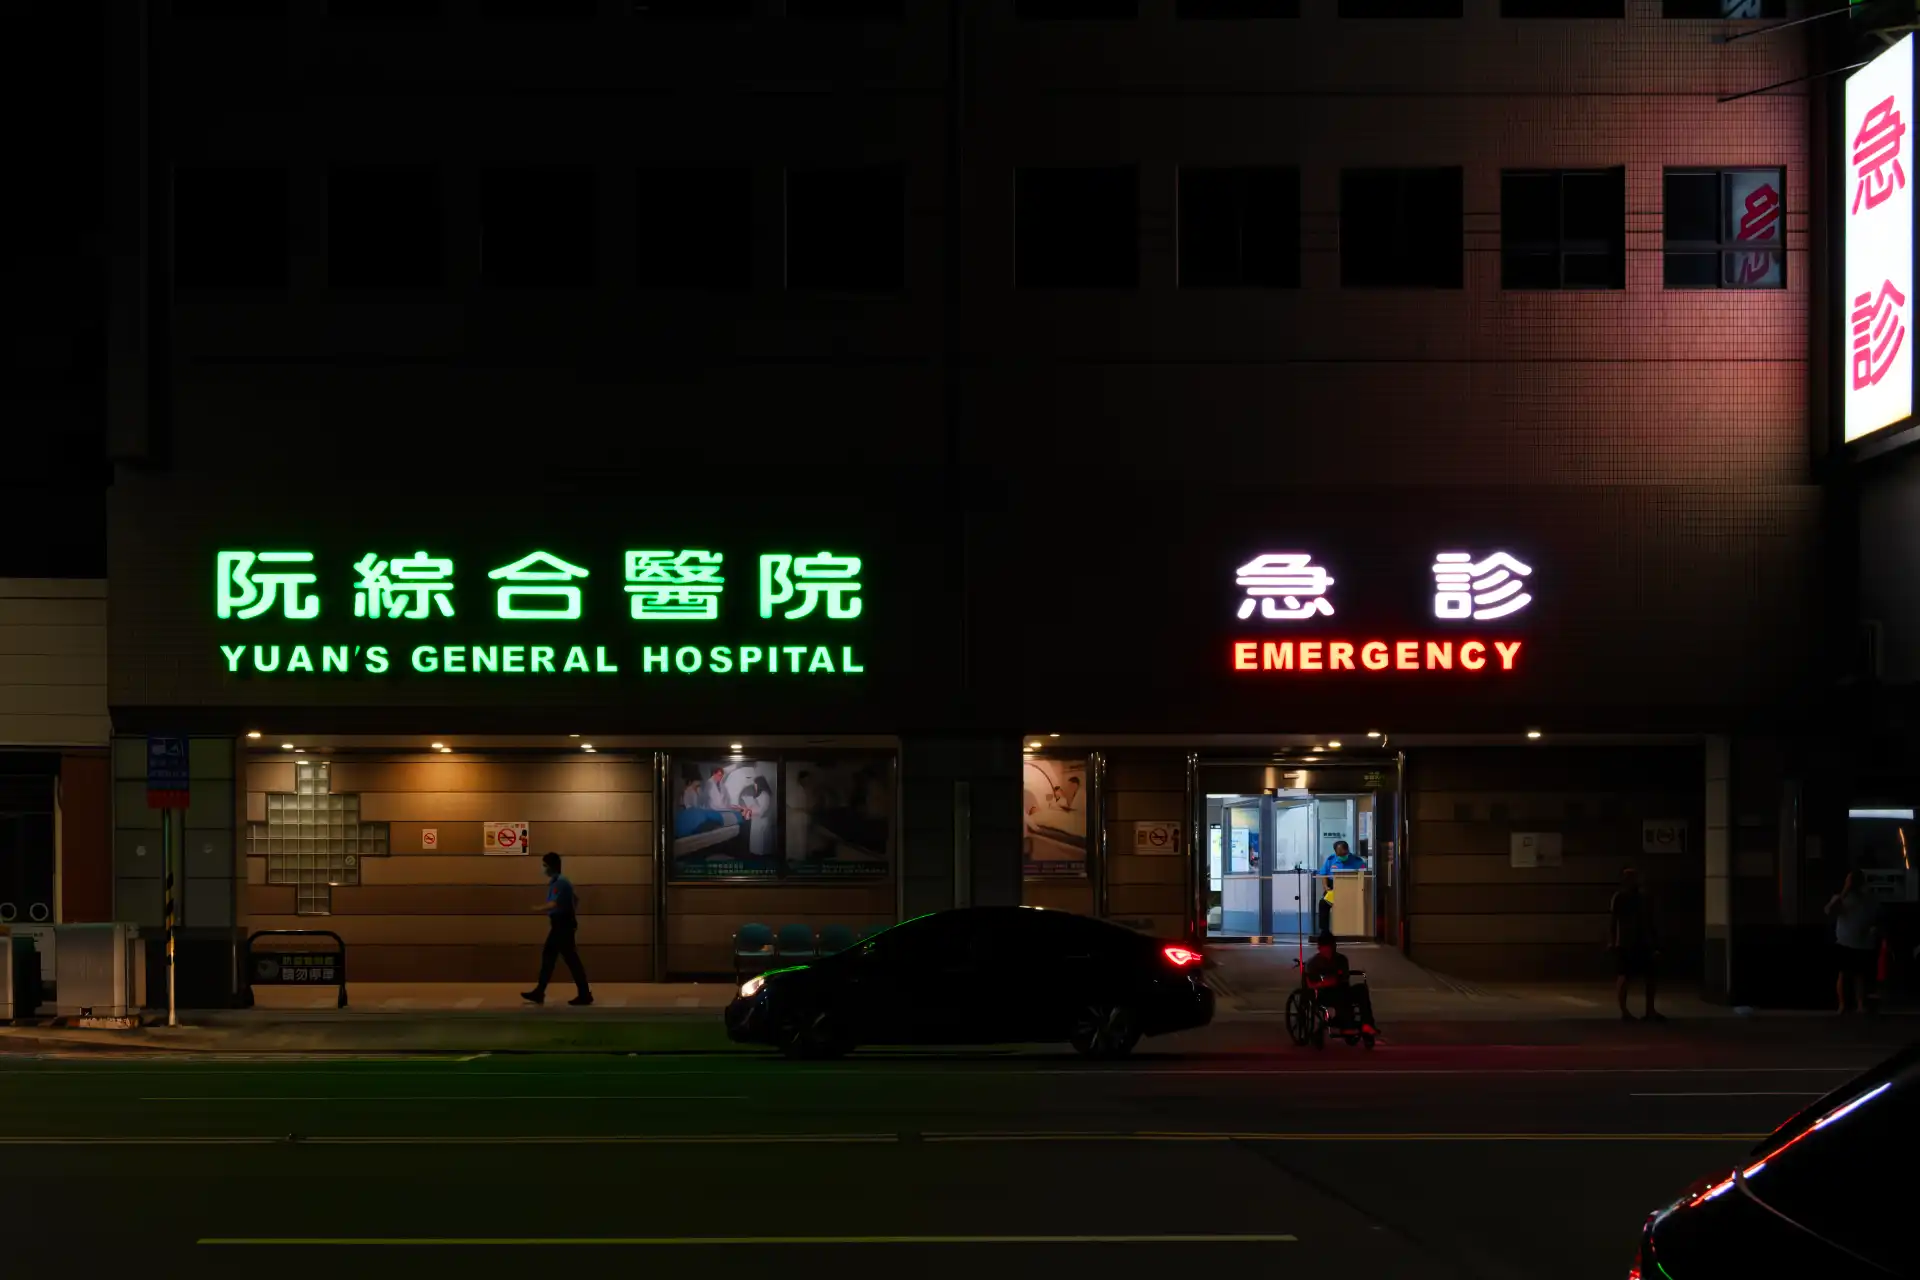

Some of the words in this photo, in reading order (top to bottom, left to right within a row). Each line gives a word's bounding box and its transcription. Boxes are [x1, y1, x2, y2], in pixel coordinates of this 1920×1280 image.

[1851, 94, 1906, 391] 急診
[216, 549, 864, 620] 阮綜合醫院
[1235, 551, 1533, 621] 急診
[220, 645, 390, 674] YUAN'S
[411, 645, 618, 673] GENERAL
[643, 645, 864, 674] HOSPITAL
[1234, 640, 1522, 671] EMERGENCY
